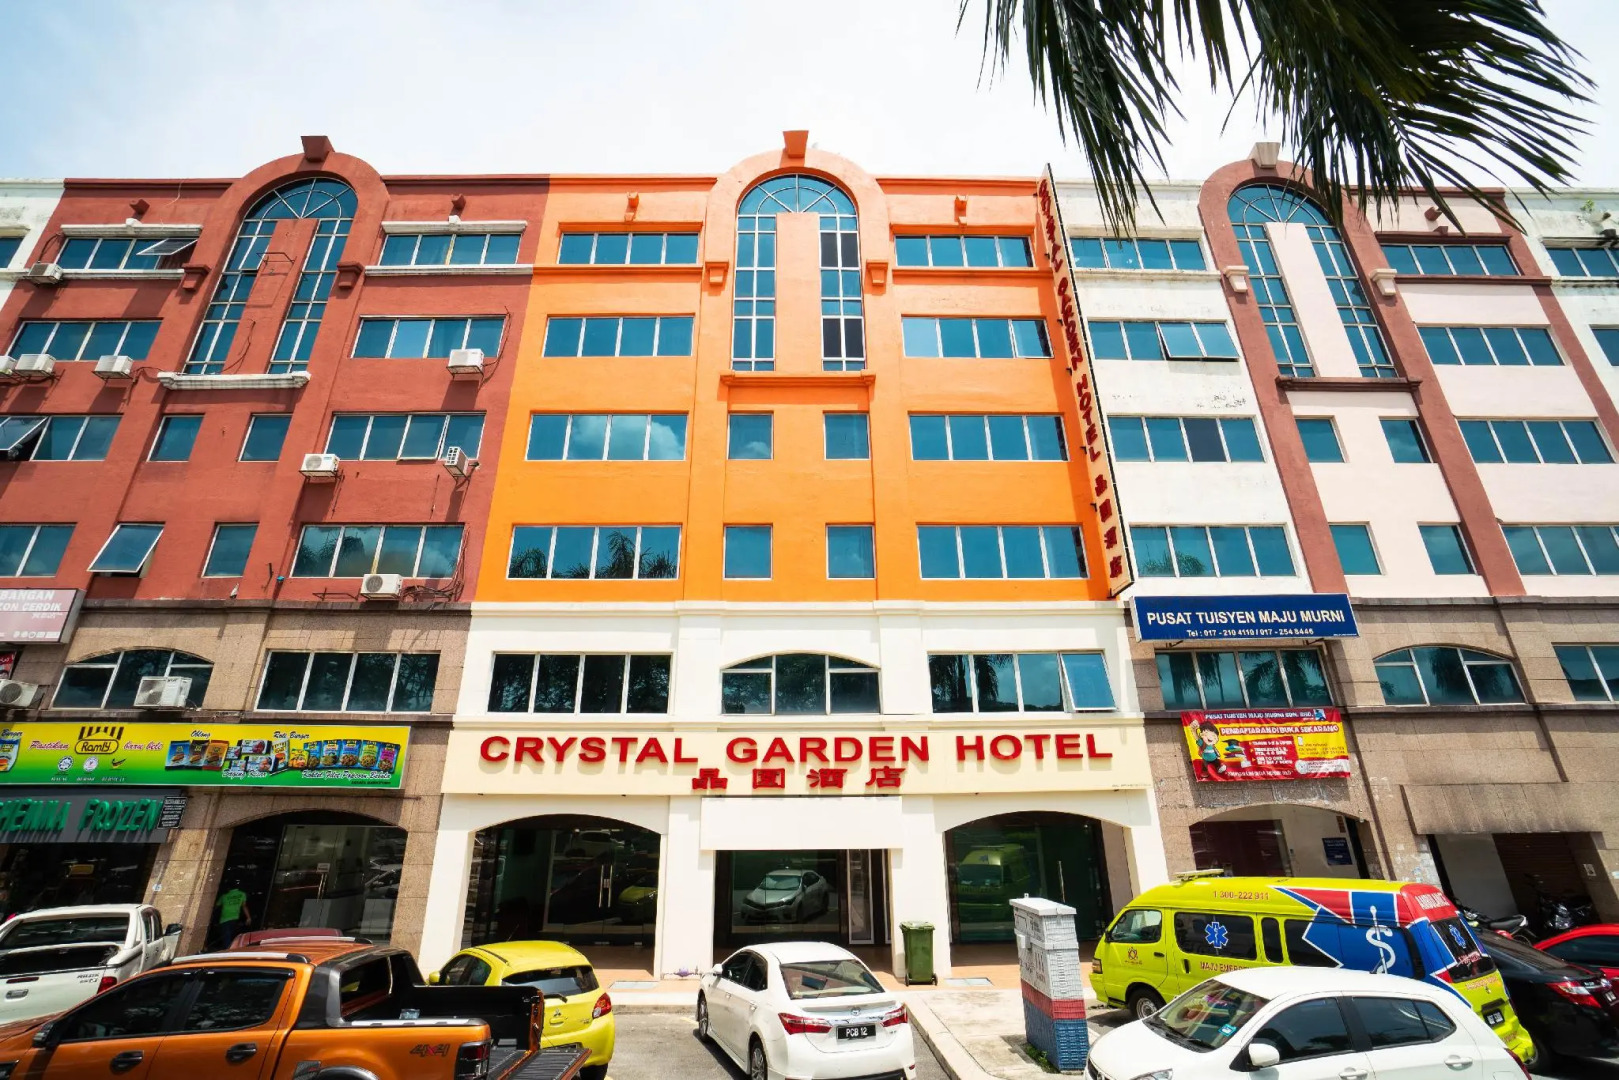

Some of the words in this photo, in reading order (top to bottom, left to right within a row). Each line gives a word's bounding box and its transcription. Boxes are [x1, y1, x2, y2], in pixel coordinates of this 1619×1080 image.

[1076, 374, 1101, 462] HOTEL
[1147, 612, 1192, 625] PUSAT
[1196, 611, 1256, 624] TUISYEN
[1258, 611, 1297, 623] MAJU
[1300, 610, 1345, 622] MURNI
[1186, 629, 1198, 637] Tel
[1260, 628, 1272, 636] 017
[290, 731, 310, 740] Burger
[480, 736, 698, 763] CRYSTAL
[726, 736, 930, 764] GARDEN
[956, 733, 1113, 761] HOTEL
[77, 799, 163, 831] FROZEN
[1255, 892, 1269, 900] 911
[1200, 962, 1218, 971] MAJU
[846, 1027, 859, 1037] PCB
[860, 1026, 868, 1036] 12
